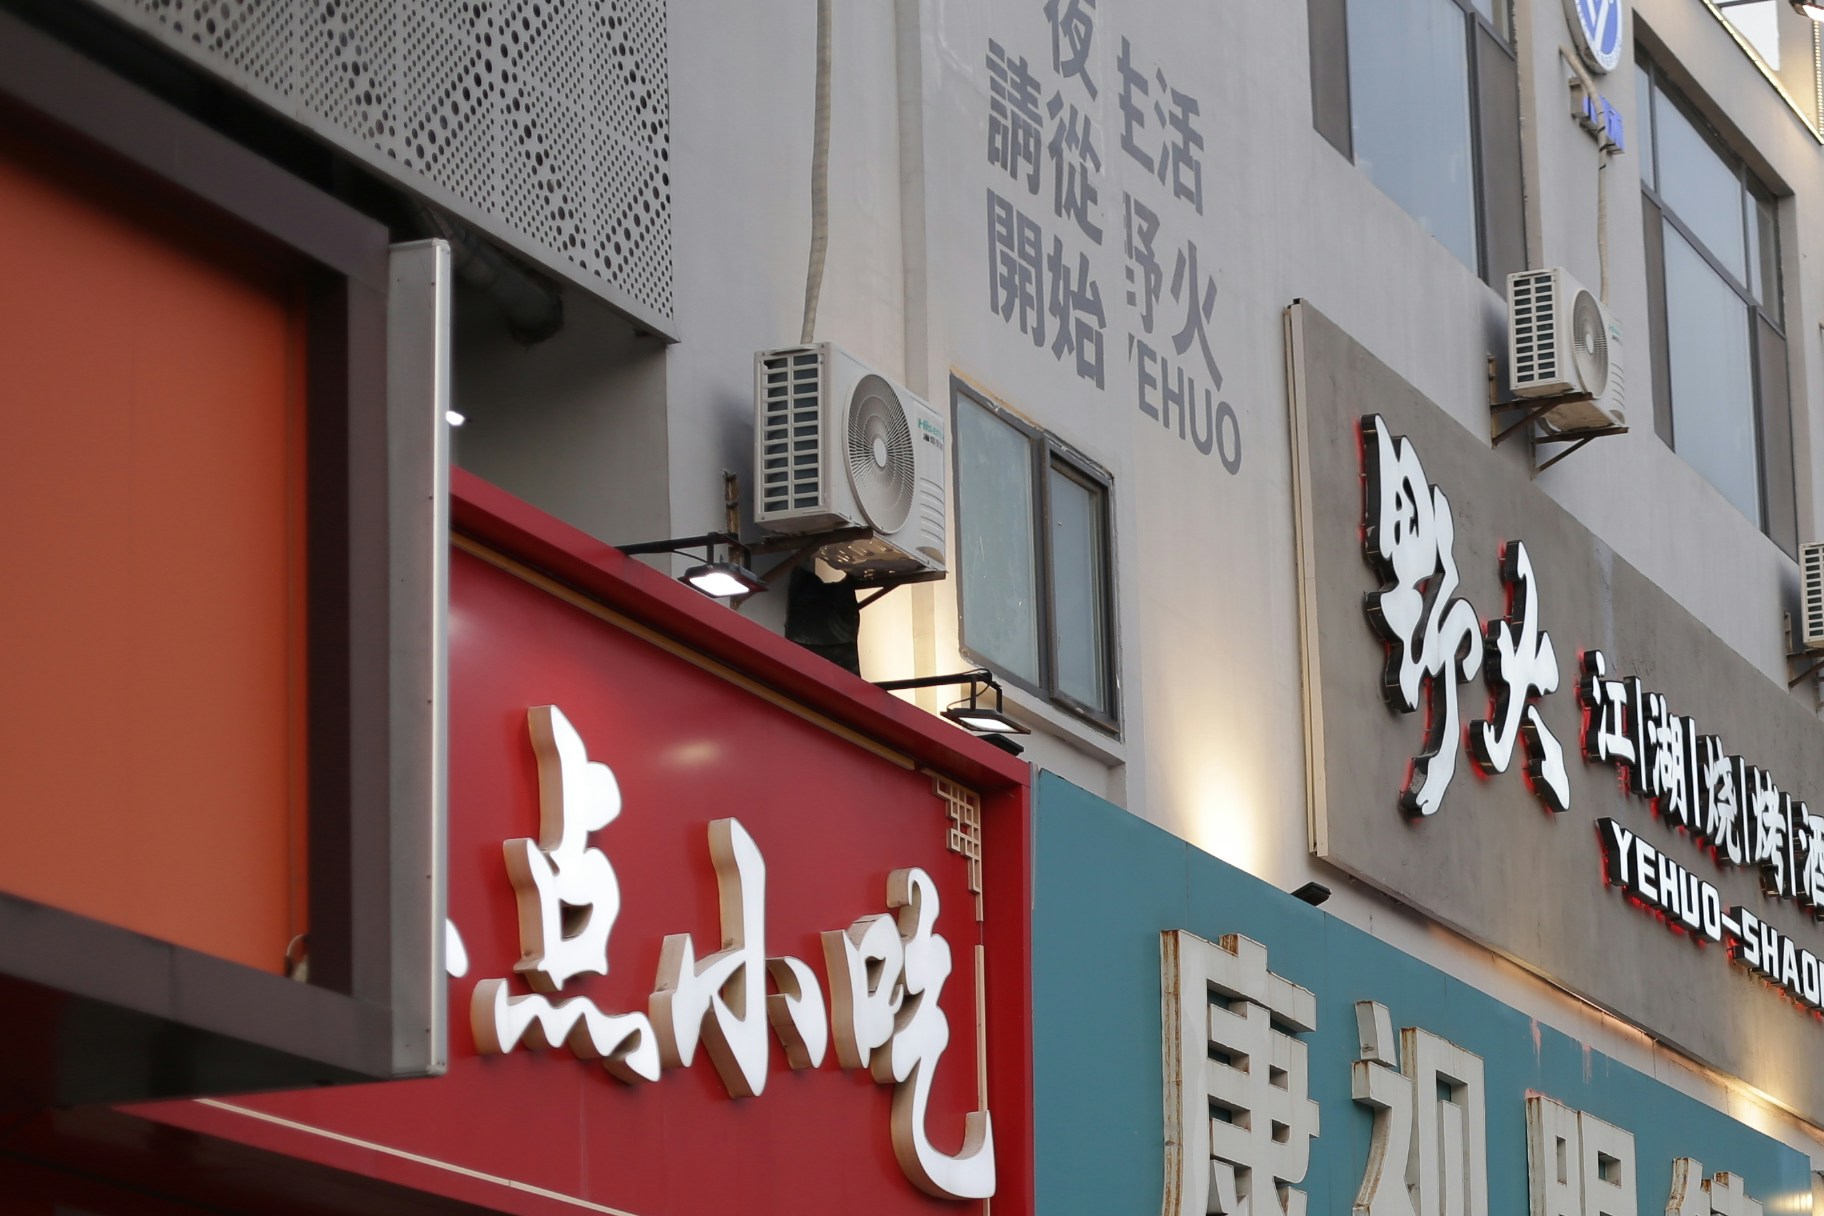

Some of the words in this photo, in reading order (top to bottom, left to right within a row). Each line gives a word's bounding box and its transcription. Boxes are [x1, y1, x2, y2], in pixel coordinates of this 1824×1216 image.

[985, 189, 1106, 391] 開始
[446, 705, 996, 1200] 点小吃
